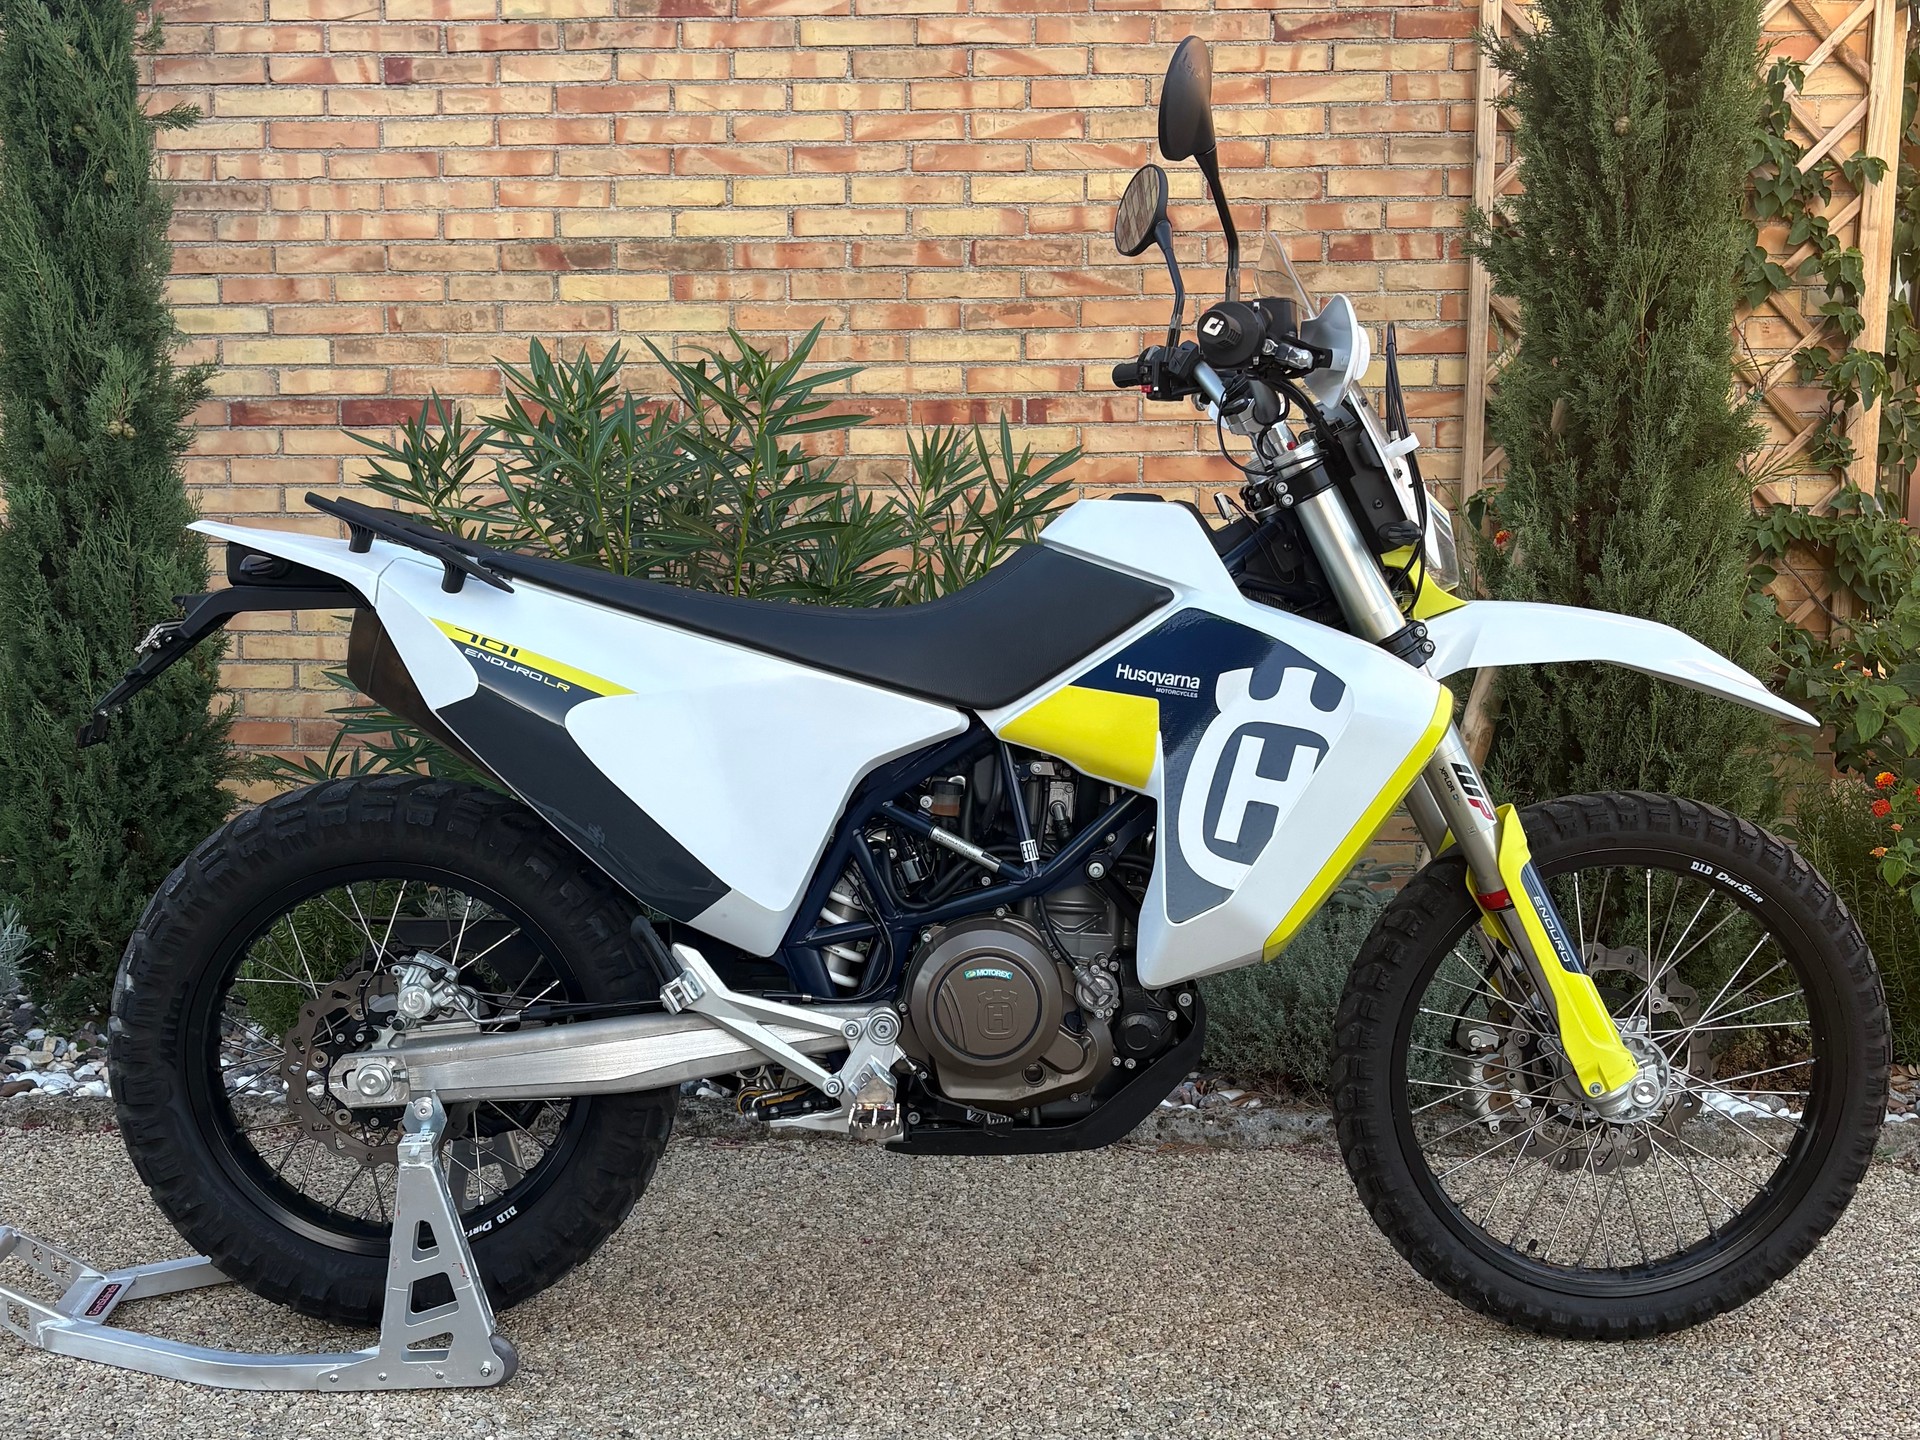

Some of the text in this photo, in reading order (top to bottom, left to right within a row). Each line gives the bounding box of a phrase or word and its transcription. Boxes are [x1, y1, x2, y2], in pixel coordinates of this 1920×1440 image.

[454, 627, 519, 657] 701
[464, 647, 571, 693] ENDURO LR
[1115, 663, 1200, 689] Husqvarna
[1155, 687, 1198, 699] MOTORCYCLES
[1533, 896, 1570, 963] ENDURO
[976, 968, 1010, 980] MOTOREX
